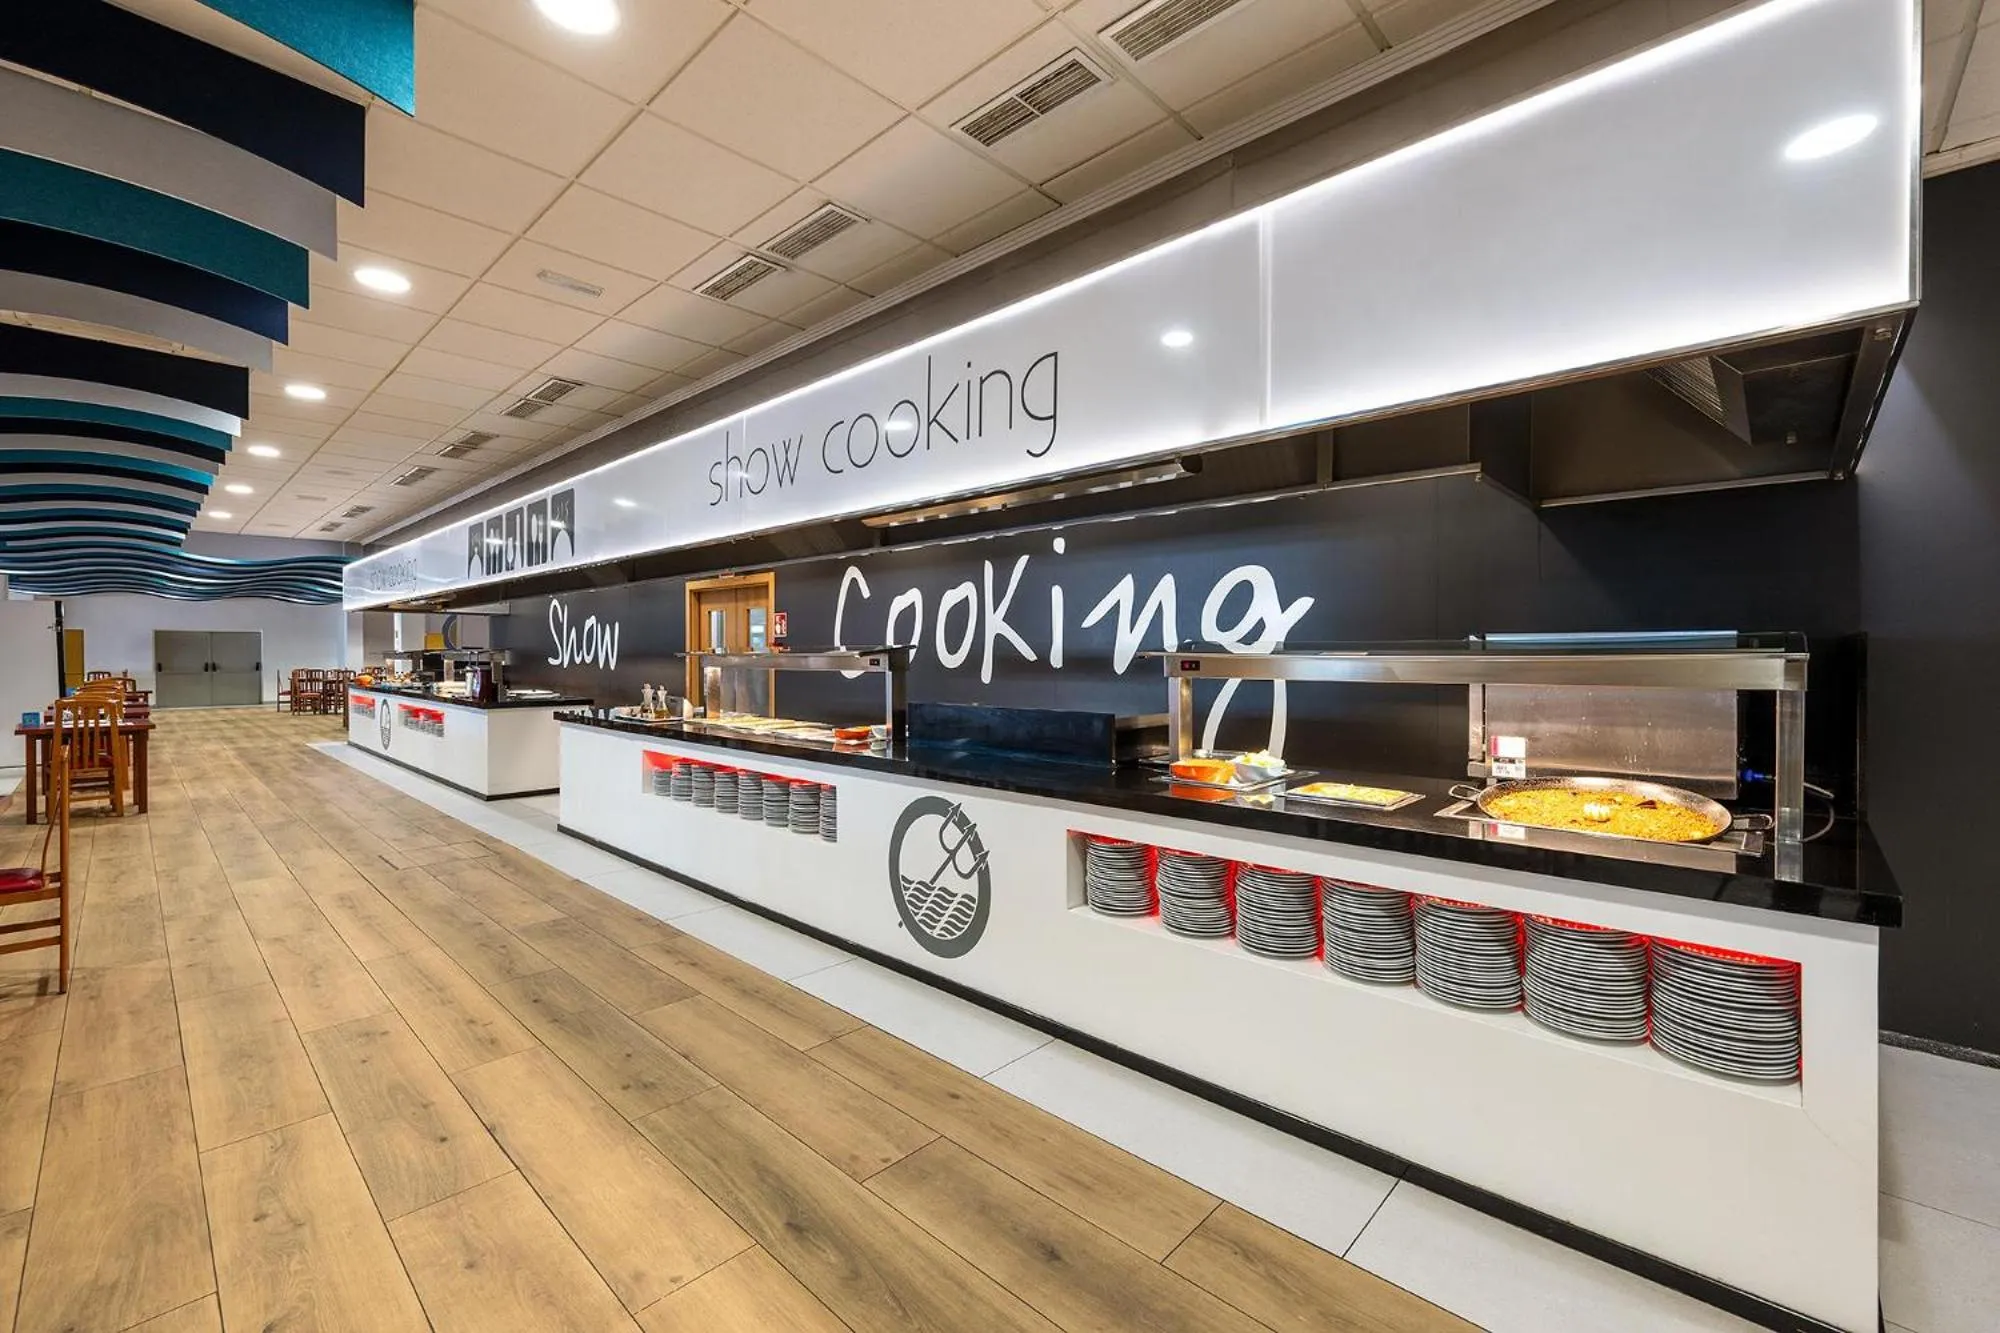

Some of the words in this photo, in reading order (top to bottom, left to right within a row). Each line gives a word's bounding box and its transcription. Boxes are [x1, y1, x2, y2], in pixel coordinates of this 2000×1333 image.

[709, 430, 804, 506] show
[822, 351, 1060, 475] cooking
[547, 598, 620, 671] Show
